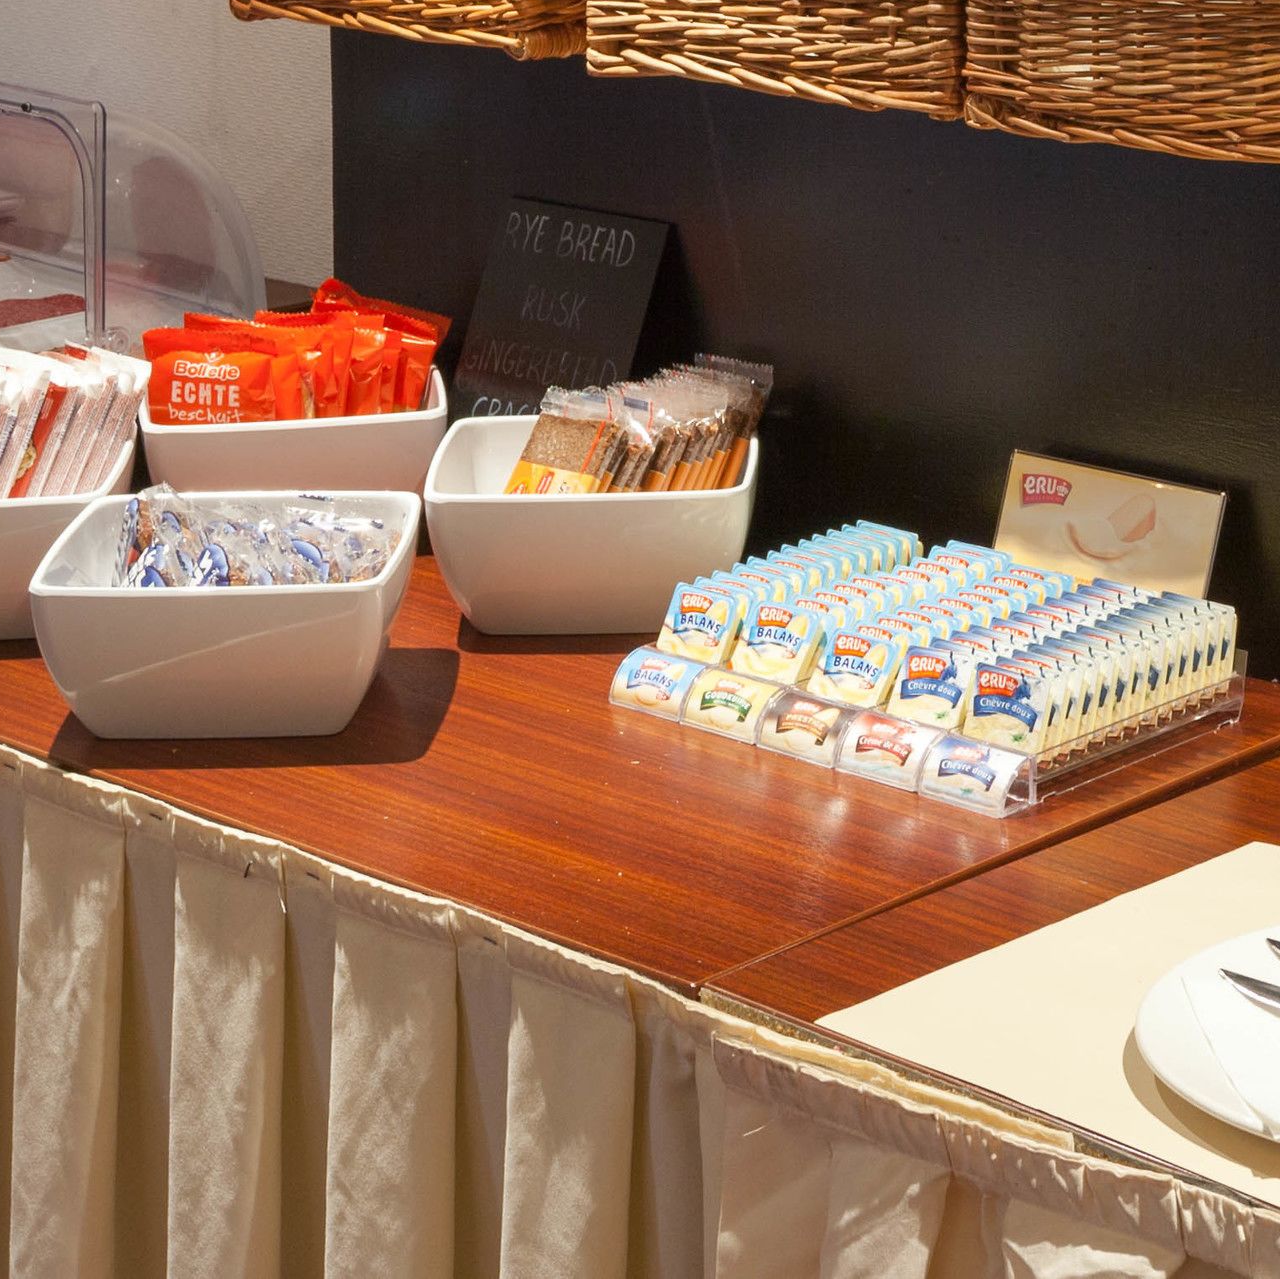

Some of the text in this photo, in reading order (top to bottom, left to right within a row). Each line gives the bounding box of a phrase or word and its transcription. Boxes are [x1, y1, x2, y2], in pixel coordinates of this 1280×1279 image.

[506, 211, 636, 268] RYE BREAD
[521, 284, 587, 330] RUSK
[171, 380, 241, 408] ECHTE
[168, 402, 245, 423] beschuit
[680, 614, 721, 634] BALANS
[756, 628, 801, 647] BALANS
[833, 656, 879, 678] BALANS
[633, 669, 674, 689] BALANS
[937, 684, 957, 698] doux
[1011, 704, 1032, 719] doux
[971, 766, 993, 782] doux
